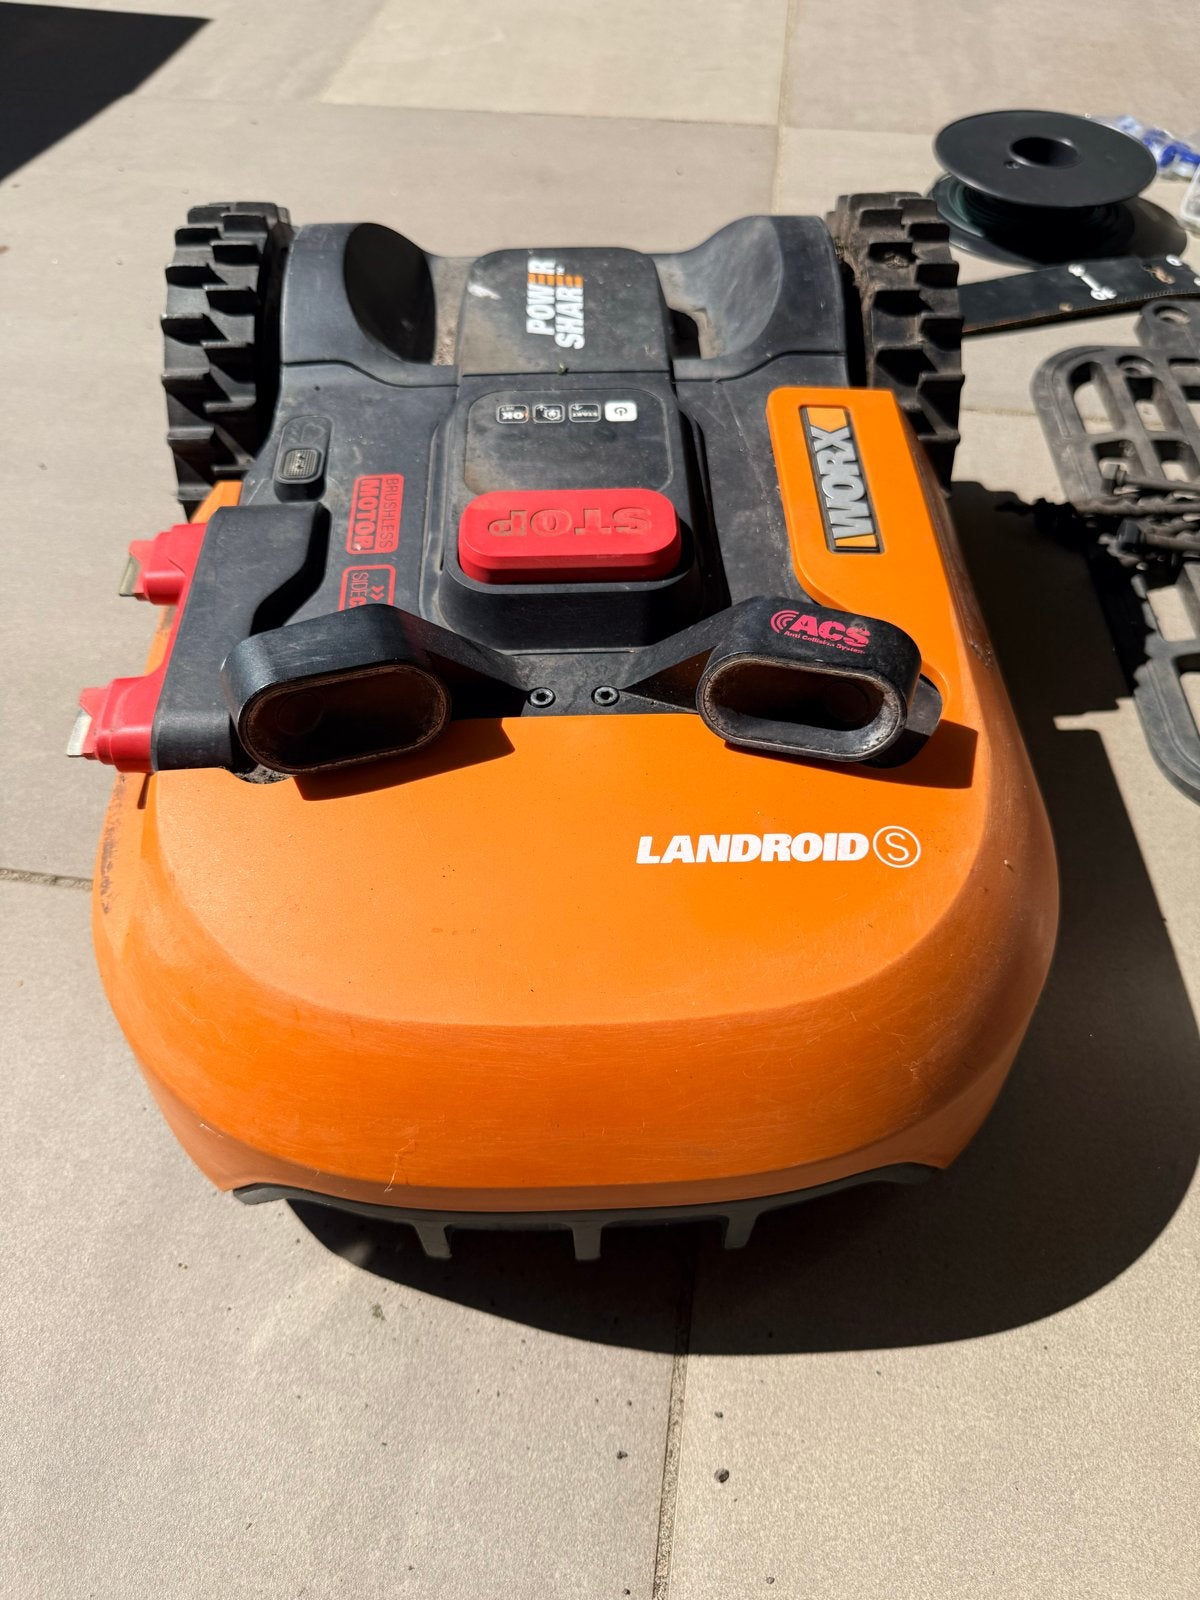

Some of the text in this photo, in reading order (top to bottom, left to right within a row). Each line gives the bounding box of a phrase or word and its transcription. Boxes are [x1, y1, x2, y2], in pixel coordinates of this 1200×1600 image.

[526, 256, 555, 336] POWER
[555, 274, 585, 350] SHARE
[502, 411, 524, 420] OK
[811, 424, 876, 539] WORX
[352, 479, 380, 549] MOTOR
[380, 478, 399, 549] BRUSHLESS
[487, 506, 652, 537] STOP
[349, 572, 369, 609] SIDEC
[784, 630, 801, 639] Anti
[789, 614, 871, 648] ACS
[636, 832, 870, 864] LANDROID
